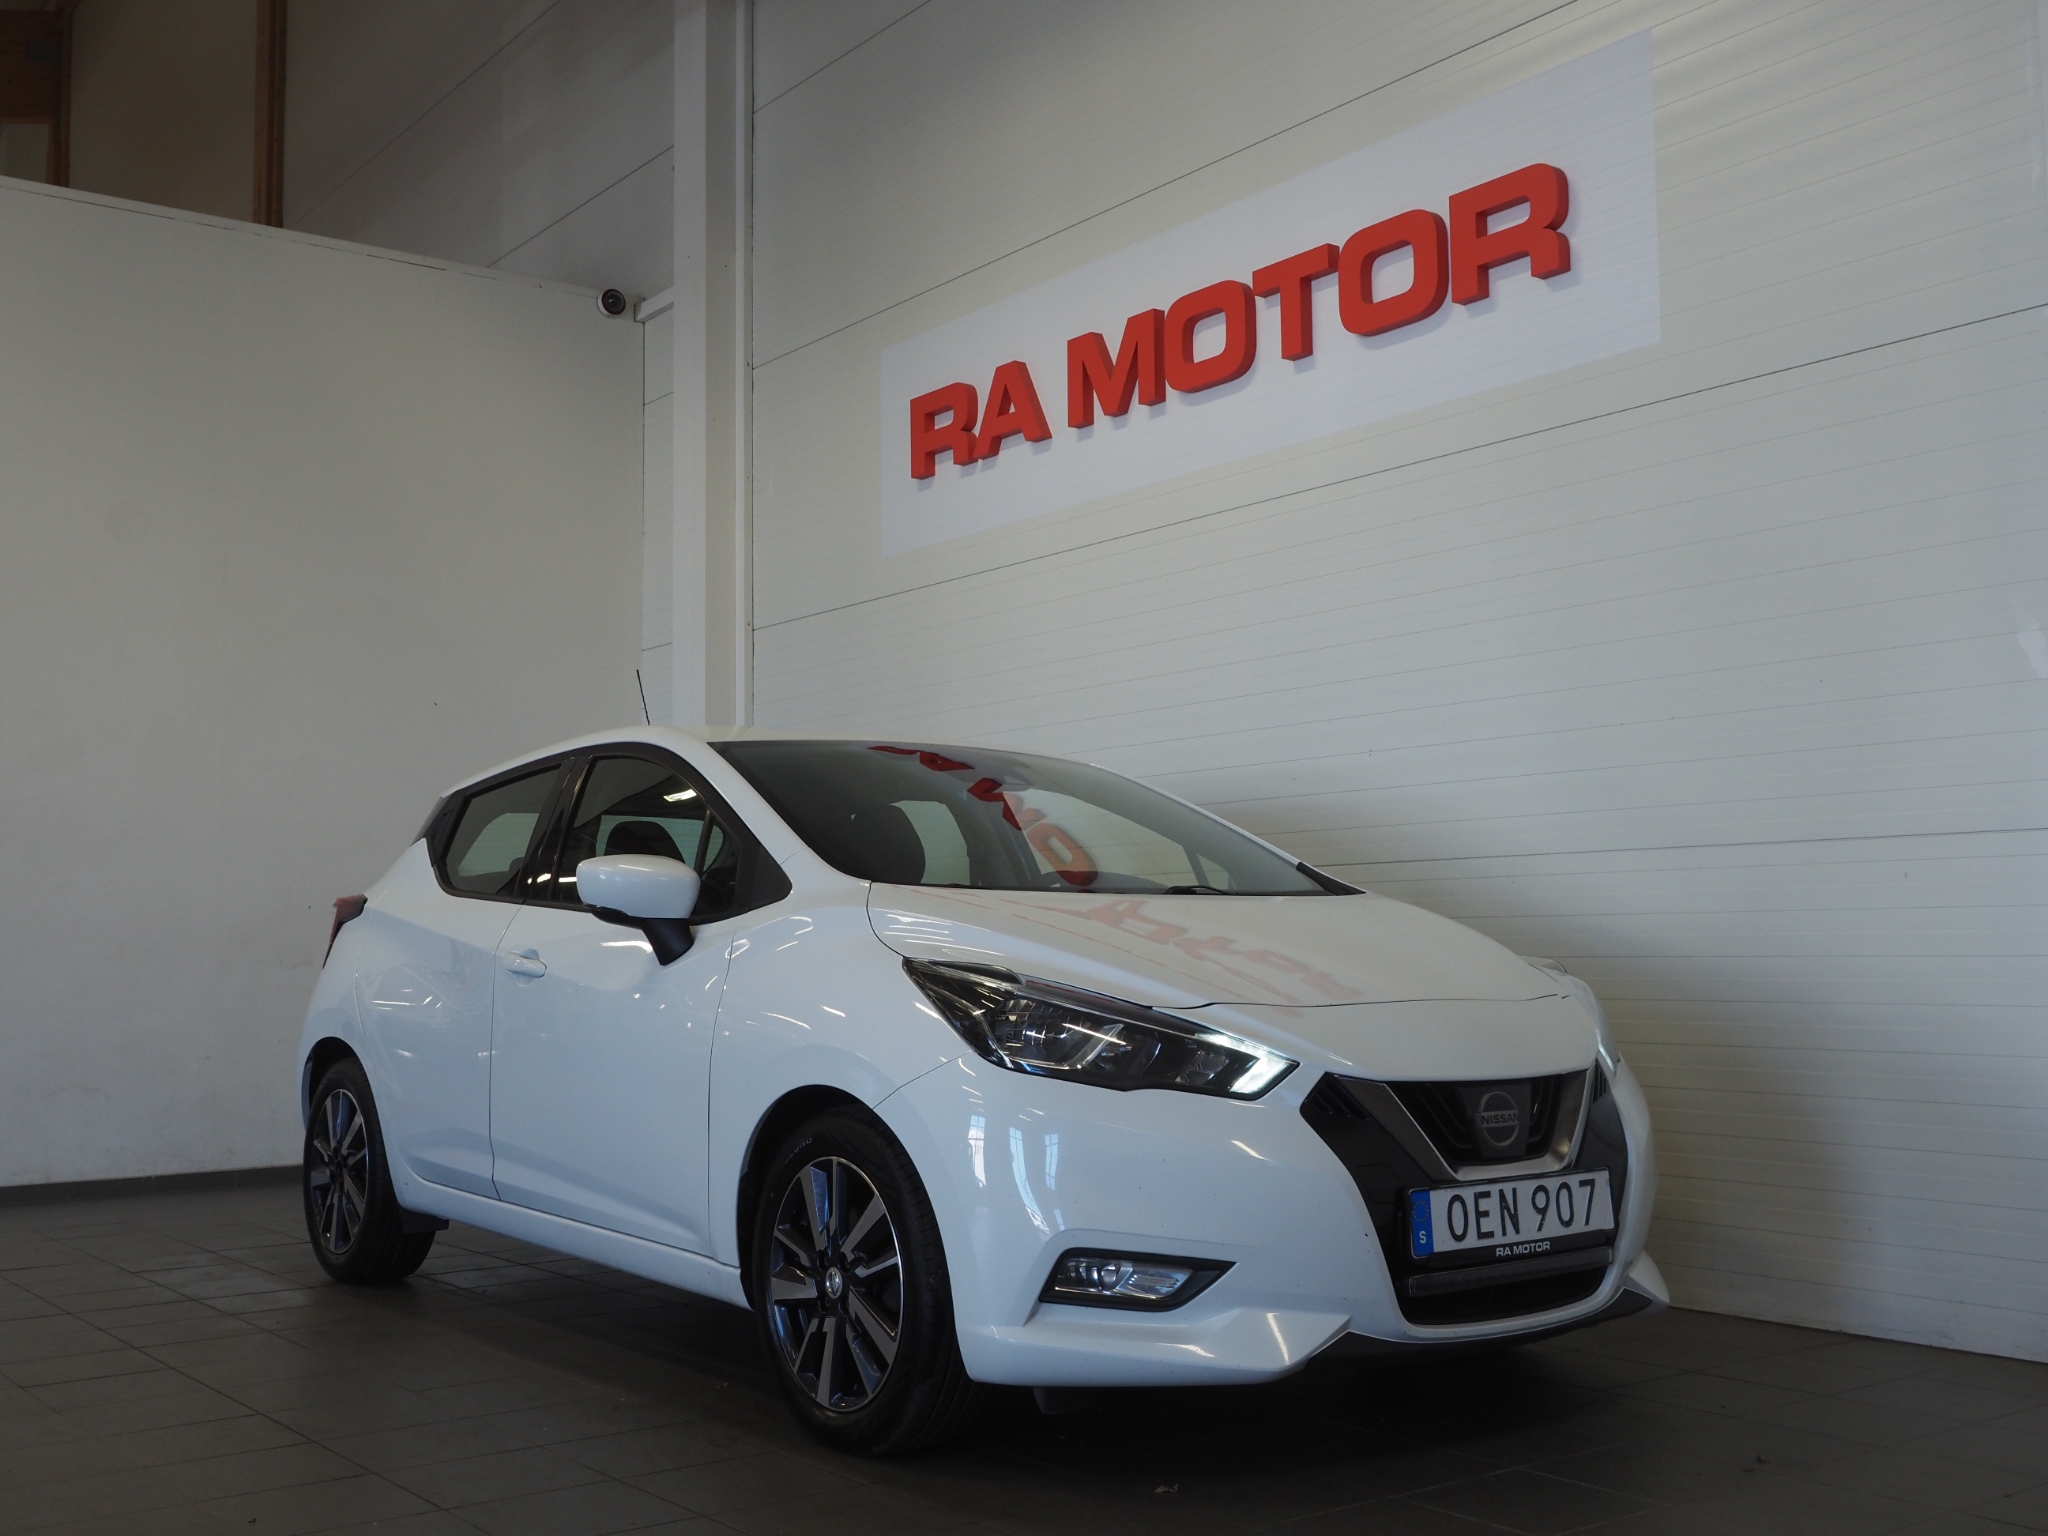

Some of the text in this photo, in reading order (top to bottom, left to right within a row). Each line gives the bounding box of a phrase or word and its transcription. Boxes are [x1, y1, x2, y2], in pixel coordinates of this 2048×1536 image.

[910, 163, 1571, 480] RA MOTOR
[1481, 1112, 1519, 1125] NISSAN
[1447, 1178, 1596, 1242] OEN 907
[1419, 1230, 1427, 1244] S
[1495, 1240, 1551, 1258] RA MOTOR
